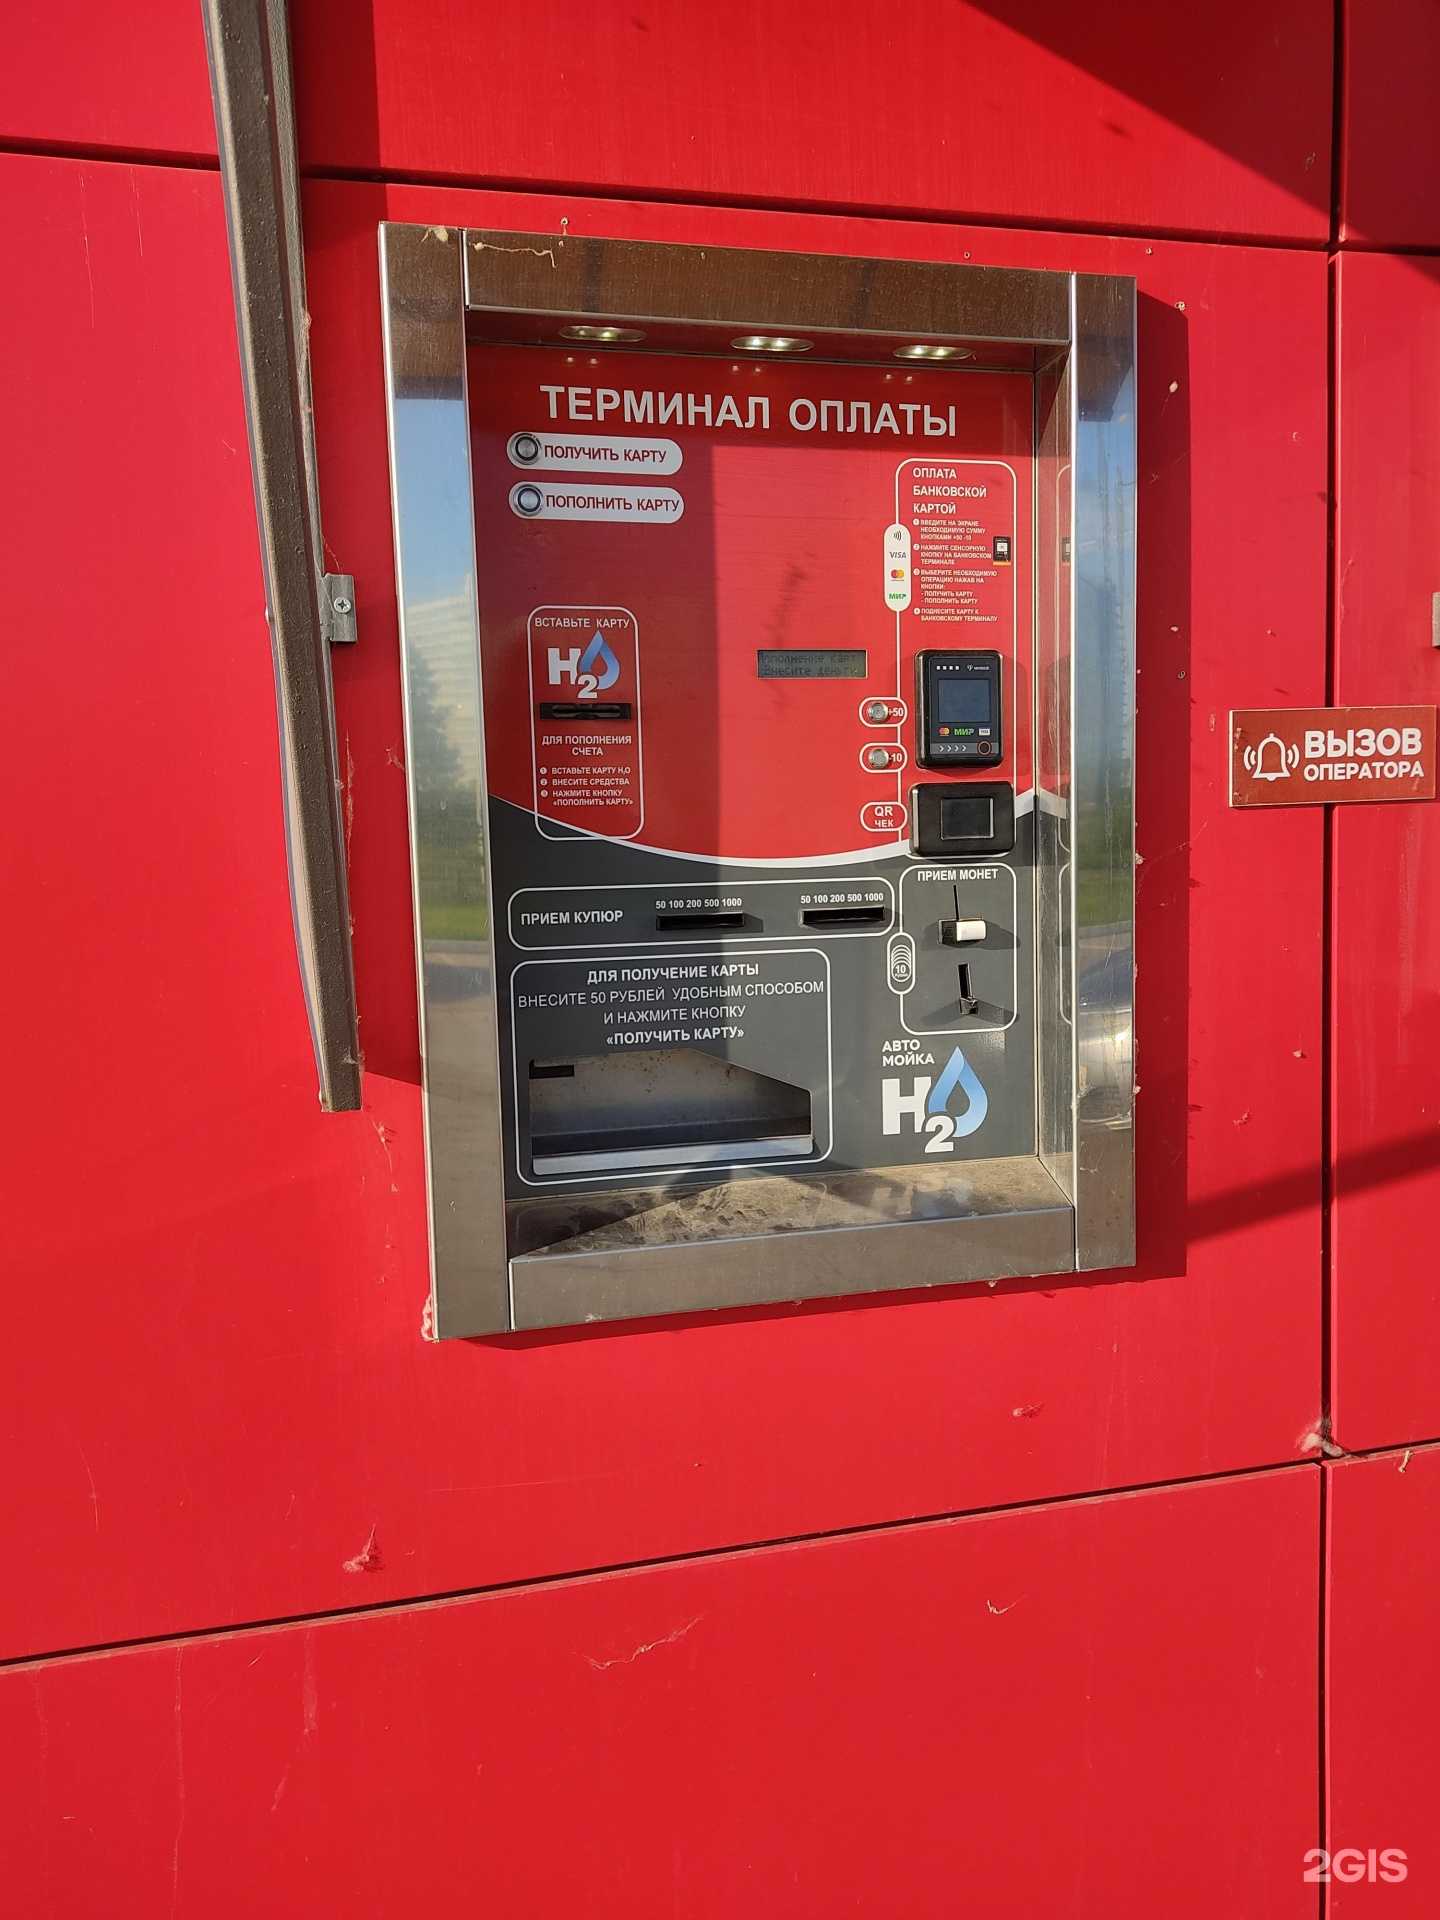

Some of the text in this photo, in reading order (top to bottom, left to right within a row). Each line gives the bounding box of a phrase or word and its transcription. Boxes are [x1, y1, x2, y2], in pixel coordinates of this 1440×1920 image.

[540, 385, 956, 437] ТЕРМИНАЛ ОПЛАТЫ
[544, 445, 667, 463] ПОЛУЧИТЬ КАРТУ
[912, 467, 957, 479] ОПЛАТА
[913, 485, 987, 498] БАНКОВСКОЙ
[546, 495, 680, 512] ПОПОЛНИТЬ КАРТУ
[913, 502, 956, 514] КАРТОЙ
[889, 551, 907, 559] VISA
[535, 617, 630, 628] ВСТАВЬТЕ КАРТУ
[954, 728, 975, 736] МИР
[541, 735, 632, 745] ДЛЯ ПОПОЛНЕНИЯ
[1304, 728, 1422, 758] ВЫЗОВ
[571, 747, 604, 756] СЧЕТА
[1303, 760, 1425, 781] ОПЕРАТОРА
[589, 778, 630, 786] СРЕДСТВА
[552, 789, 591, 797] НАЖМИТЕ
[592, 789, 622, 797] КНОПКУ
[553, 798, 605, 806] «ПОПОЛНИТЬ
[874, 805, 894, 817] QR
[874, 819, 894, 828] ЧЕК
[917, 869, 999, 881] ПРИЕМ МОНЕТ
[655, 897, 742, 909] 50 100 200 500 1000
[800, 892, 884, 904] 50 100 200 500 1000
[521, 910, 624, 925] ПРИЕМ КУПЮР
[587, 963, 759, 985] ДЛЯ ПОЛУЧЕНИЕ КАРТЫ
[894, 964, 907, 973] 10
[518, 981, 824, 1008] ВНЕСИТЕ 50 РУБЛЕЙ УДОБНЫМ СПОСОБОМ
[603, 1005, 746, 1024] И НАЖМИТЕ КНОПКУ
[606, 1026, 745, 1045] «ПОЛУЧИТЬ КАРТУ»
[882, 1039, 921, 1052] АВТО
[882, 1052, 935, 1067] МОЙКА
